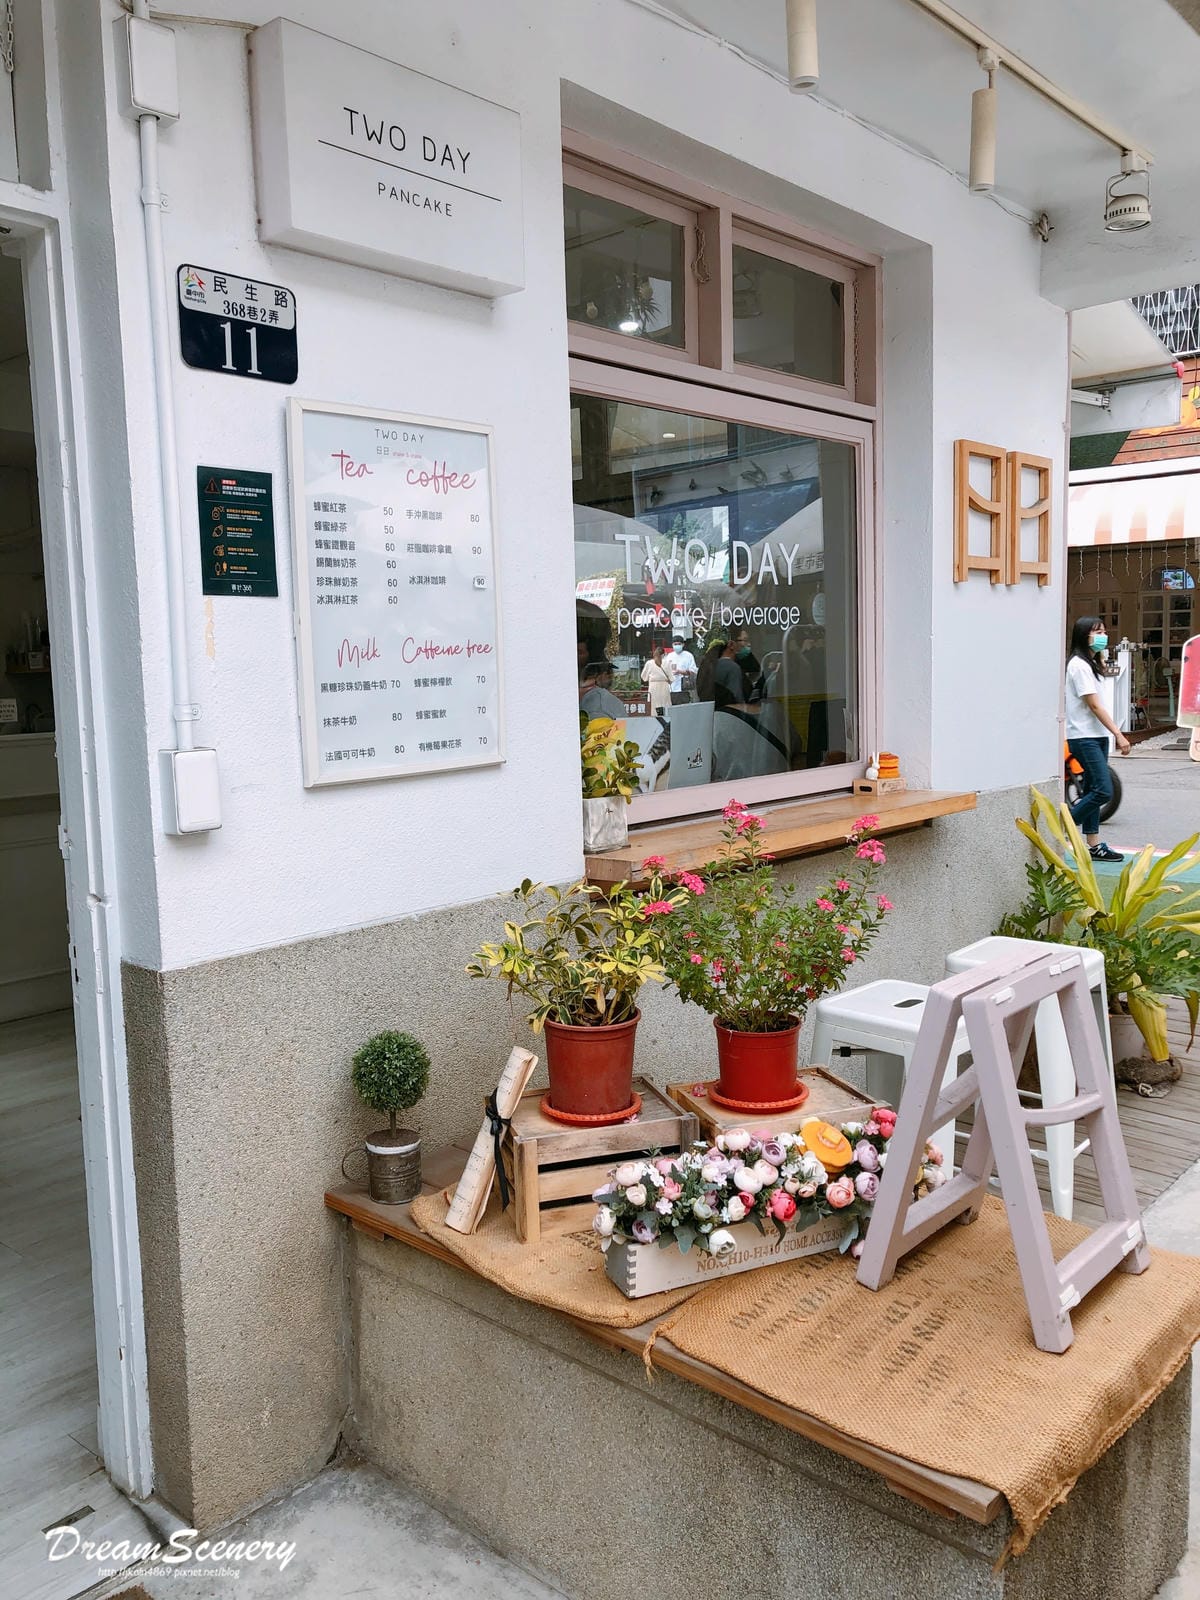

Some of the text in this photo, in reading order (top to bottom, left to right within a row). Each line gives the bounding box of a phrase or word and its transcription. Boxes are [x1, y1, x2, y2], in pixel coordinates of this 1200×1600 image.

[343, 107, 471, 174] TWO DAY
[378, 182, 453, 217] PANCAKE
[213, 275, 289, 309] 民生路
[222, 299, 280, 325] 368巷2弄
[219, 320, 263, 376] 11
[375, 428, 424, 444] TWO DAY
[331, 449, 374, 480] tea
[406, 460, 477, 495] coffee
[313, 501, 394, 516] 蜂蜜紅茶 50
[470, 514, 480, 523] 80
[314, 521, 395, 535] 蜂蜜綠茶 50
[315, 539, 395, 552] 蜂蜜鐵觀音 60
[471, 546, 482, 555] 90
[315, 557, 397, 569] 錫蘭鮮奶茶 60
[614, 533, 800, 586] TWO DAY
[316, 576, 398, 588] 珍珠鮮奶茶 60
[408, 575, 447, 586] 冰淇淋咖啡
[316, 594, 398, 605] 冰淇淋紅茶 60
[617, 601, 704, 634] pancake
[720, 601, 800, 631] beverage
[337, 636, 381, 669] Milk
[401, 636, 464, 664] Caffeine
[391, 680, 401, 689] 70
[476, 675, 486, 684] 70
[477, 706, 487, 715] 70
[323, 712, 402, 728] 抹茶牛奶 80
[478, 736, 488, 745] 70
[325, 745, 405, 762] 法國可可牛奶 80
